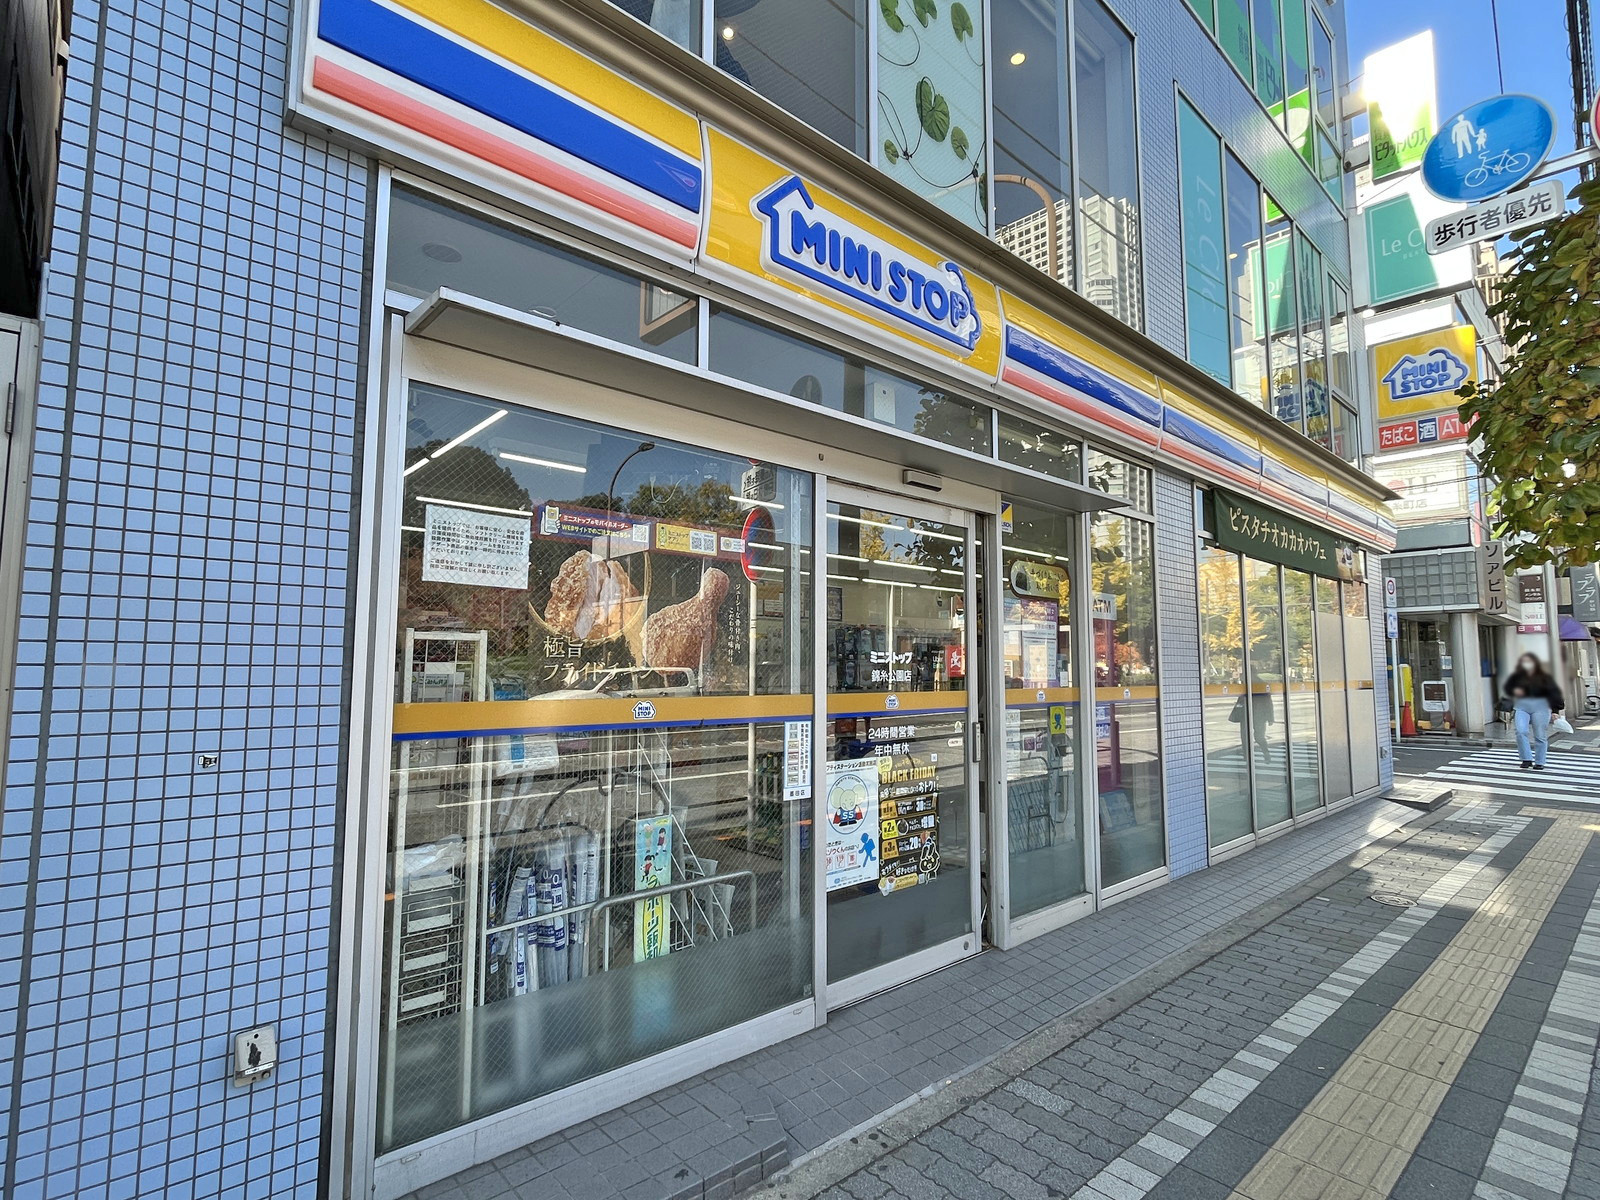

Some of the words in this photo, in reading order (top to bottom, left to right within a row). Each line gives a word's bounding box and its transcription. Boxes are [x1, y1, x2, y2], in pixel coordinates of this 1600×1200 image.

[1435, 192, 1552, 247] 歩行者優先
[1381, 238, 1402, 257] Le
[791, 209, 882, 292] MINI
[888, 260, 969, 328] STOP
[1402, 359, 1448, 379] MINI
[1400, 372, 1451, 394] STOP
[1381, 424, 1415, 446] たばこ
[1418, 420, 1437, 441] 酒
[1229, 506, 1327, 561] ピスタチオカカオパフェ
[1485, 544, 1504, 611] ソアビル
[1092, 598, 1112, 614] ATM
[543, 635, 584, 659] 極旨
[870, 650, 913, 664] ミニストップ
[543, 661, 654, 683] フライドチキン
[871, 669, 913, 683] 錦糸公園店
[868, 725, 916, 740] 24時間営業
[874, 742, 910, 757] 年中無休
[881, 769, 909, 785] BLACK
[909, 765, 937, 781] FRIDAY
[842, 811, 854, 820] SS
